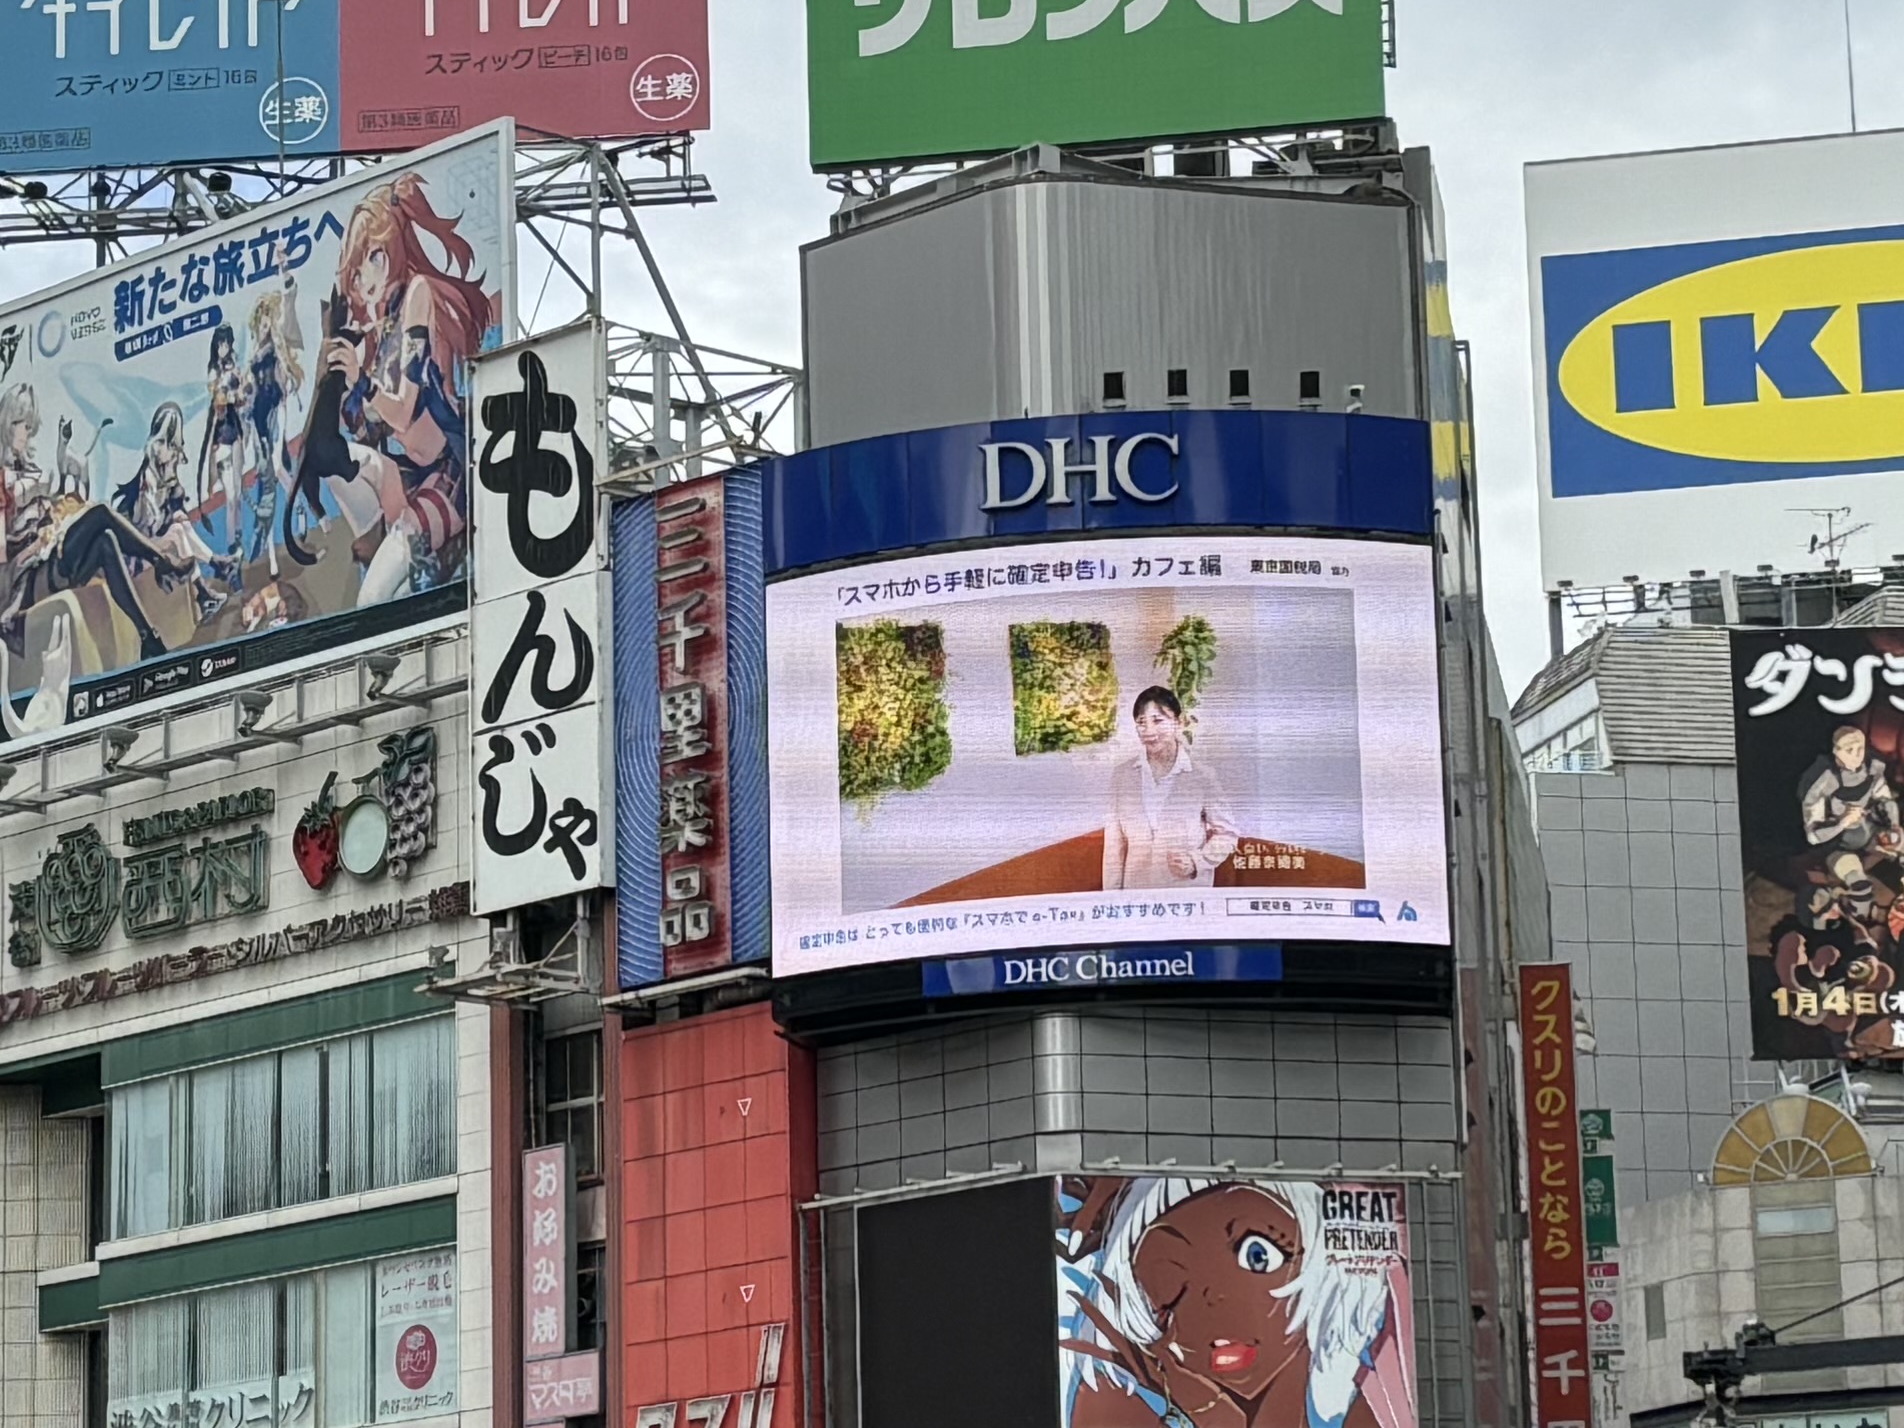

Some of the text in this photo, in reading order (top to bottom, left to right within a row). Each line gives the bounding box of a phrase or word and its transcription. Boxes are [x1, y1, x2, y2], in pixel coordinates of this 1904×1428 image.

[262, 90, 324, 127] 生薬
[634, 70, 695, 104] 生薬
[112, 210, 345, 335] 新たな旅立ちへ
[978, 432, 1181, 512] DHC
[479, 350, 597, 880] もんじゃ
[655, 496, 714, 948] 三千里薬品
[1002, 952, 1195, 985] DHC Channel
[1531, 978, 1573, 1260] クスリのことなら
[1322, 1190, 1398, 1223] GREAT
[1324, 1227, 1399, 1253] PRETENDER
